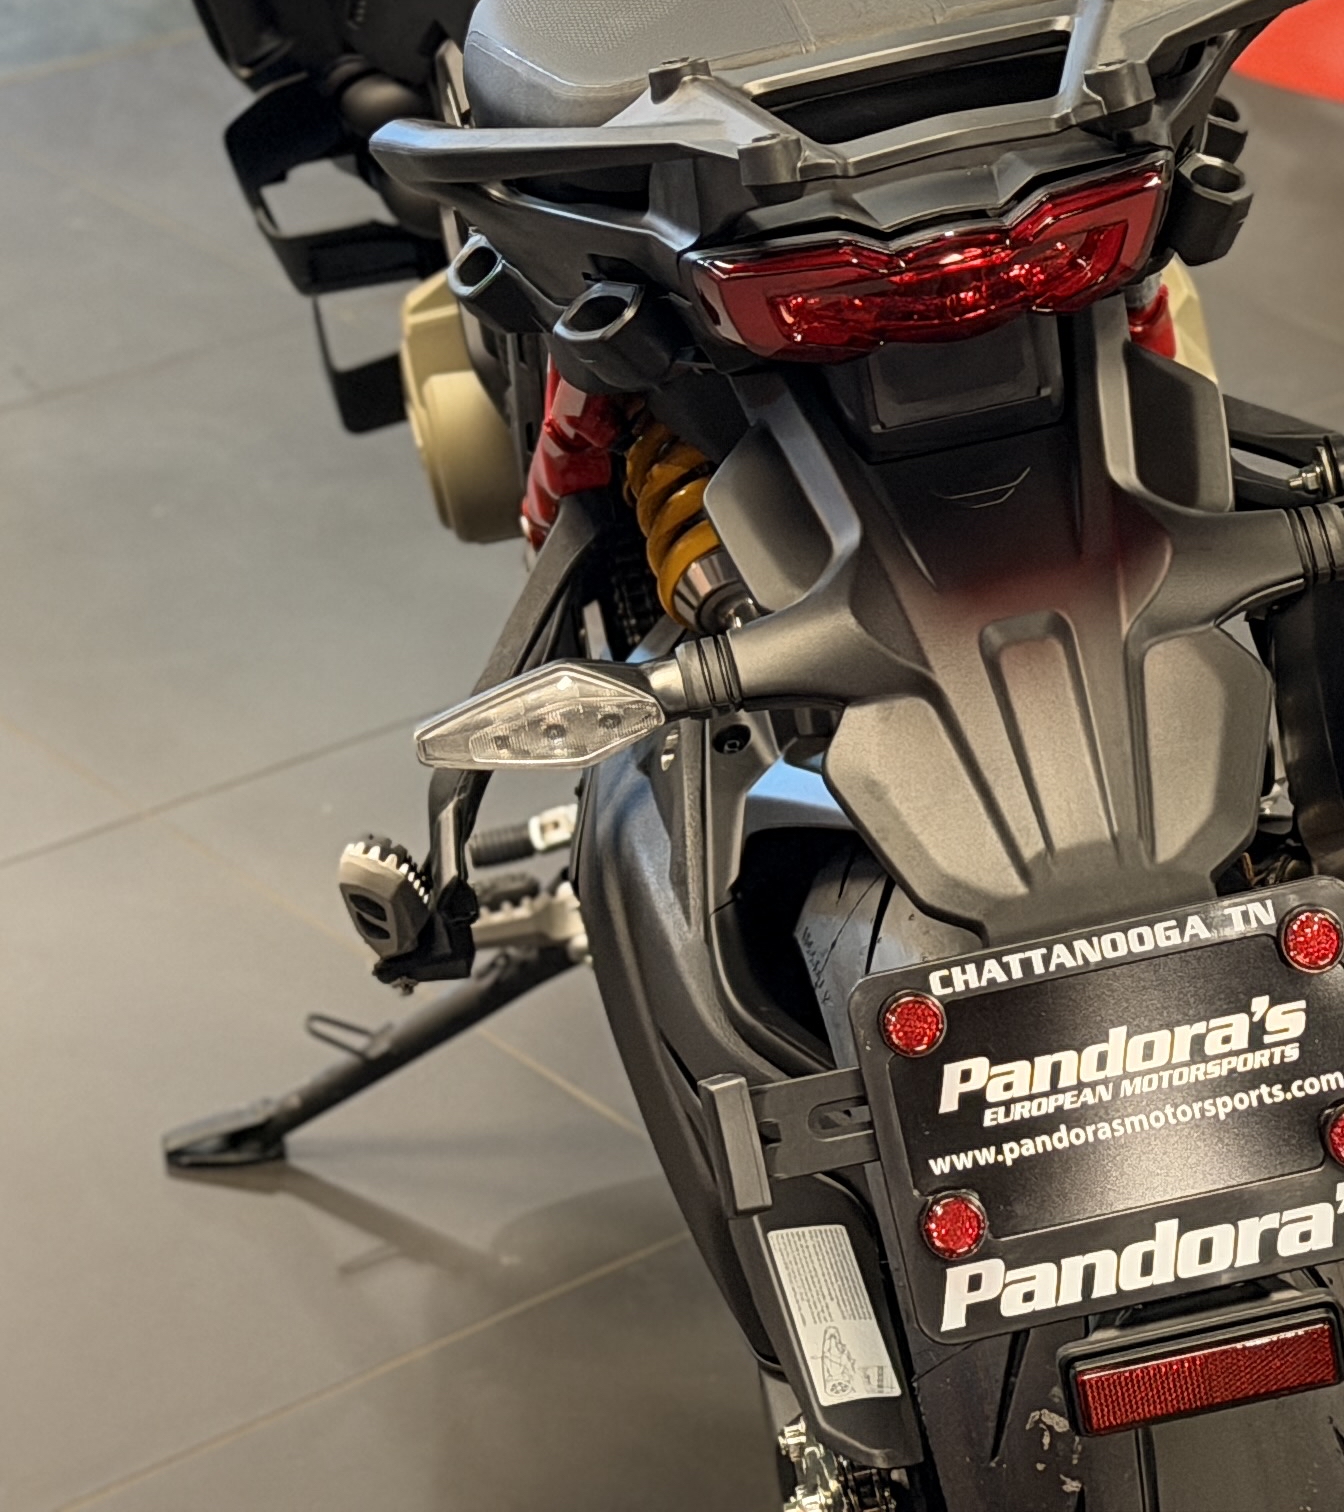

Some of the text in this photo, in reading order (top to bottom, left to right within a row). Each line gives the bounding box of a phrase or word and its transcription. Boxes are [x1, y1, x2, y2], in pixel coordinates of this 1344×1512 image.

[1223, 899, 1277, 932] TN
[938, 995, 1307, 1114] Pandora's
[982, 1043, 1300, 1127] EUROPEAN MOTORSPORTS
